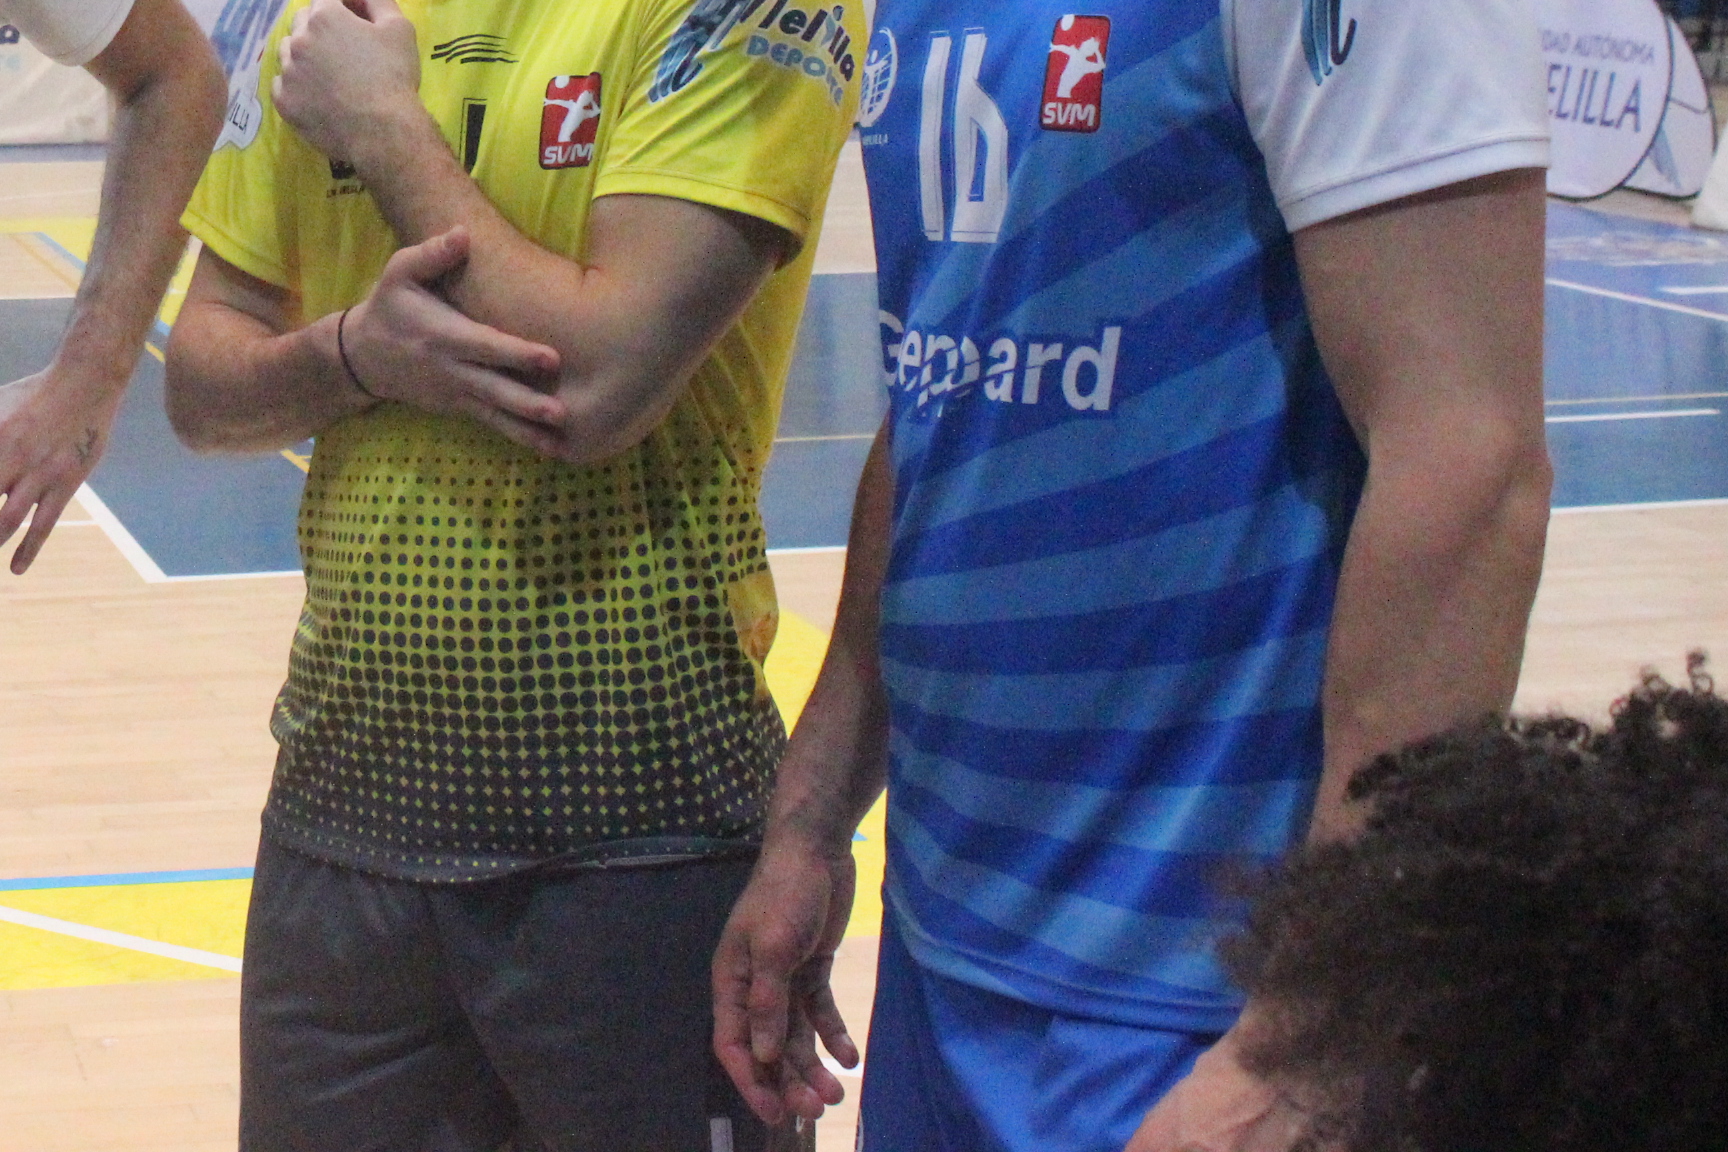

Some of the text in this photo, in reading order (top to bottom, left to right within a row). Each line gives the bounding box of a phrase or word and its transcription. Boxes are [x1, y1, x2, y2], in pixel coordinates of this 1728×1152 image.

[1042, 101, 1096, 127] SVM
[1546, 63, 1642, 133] ELILLA
[919, 26, 1009, 244] 16
